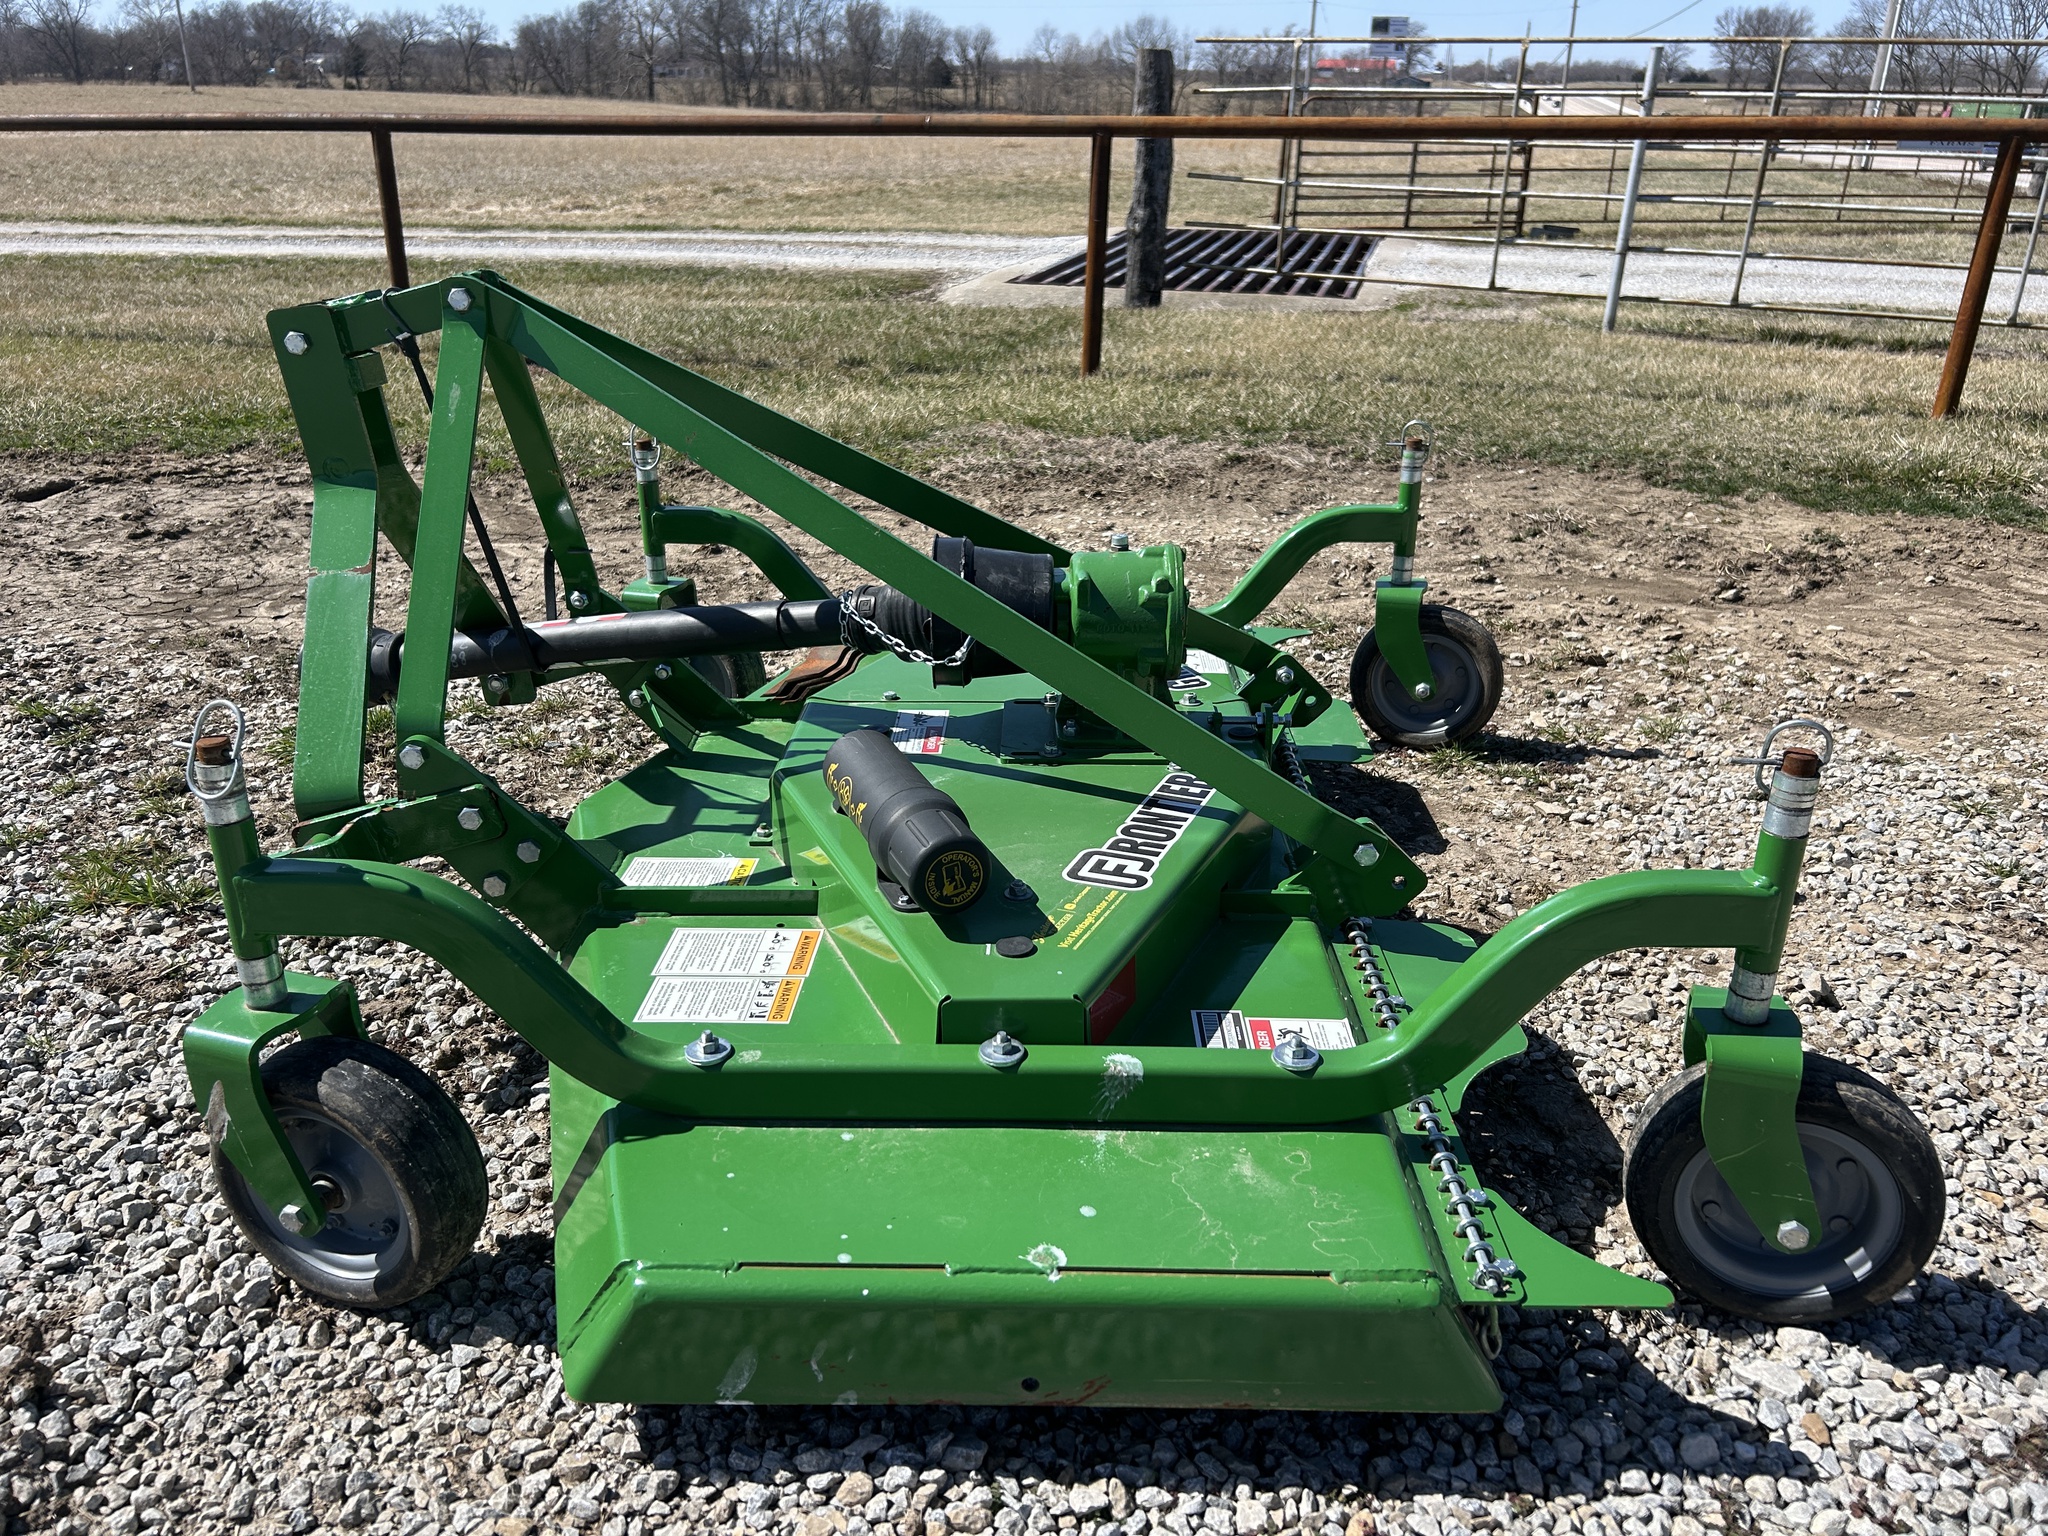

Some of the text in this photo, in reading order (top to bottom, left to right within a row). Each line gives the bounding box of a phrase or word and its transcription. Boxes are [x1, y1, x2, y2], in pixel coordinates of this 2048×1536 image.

[1066, 774, 1213, 889] FRONTIER
[928, 853, 980, 904] OPERATOR'S MANUAL INSIDE
[793, 938, 813, 970] WARNING
[772, 986, 794, 1020] WARNING
